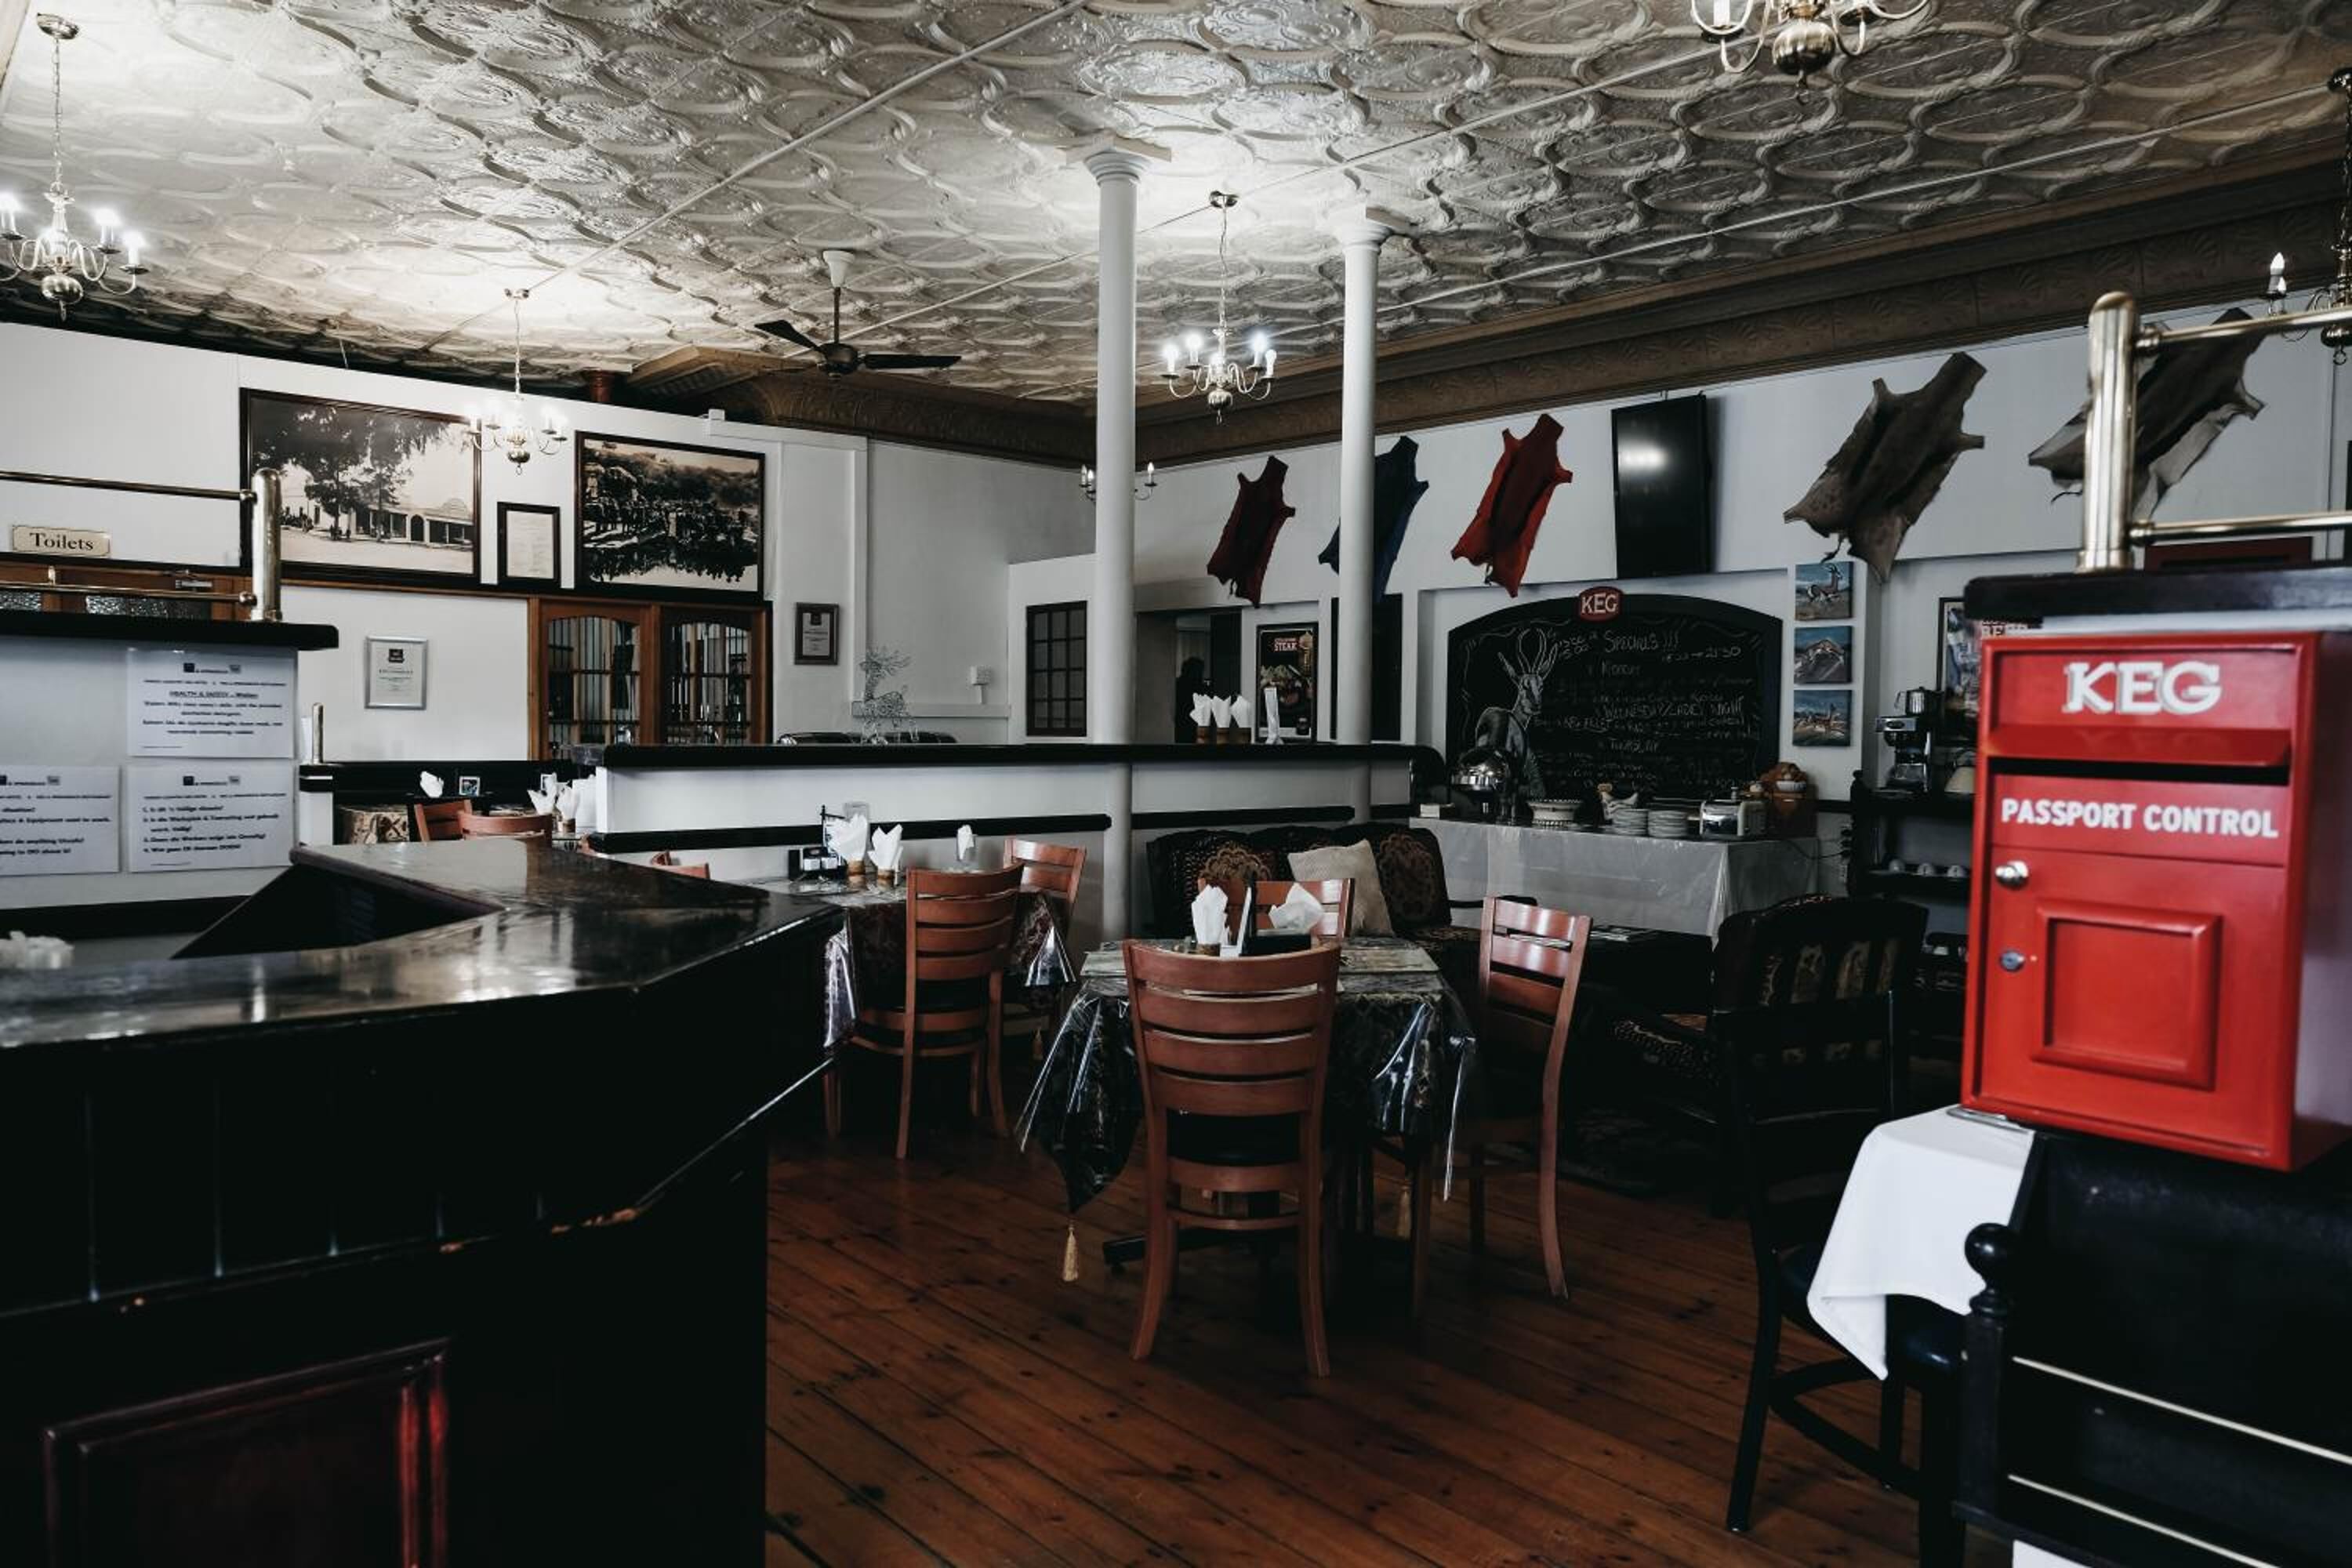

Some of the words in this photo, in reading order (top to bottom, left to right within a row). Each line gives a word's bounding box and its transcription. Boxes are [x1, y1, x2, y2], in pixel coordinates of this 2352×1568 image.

[30, 532, 93, 550] Toilets
[1581, 592, 1618, 613] KEG
[1274, 642, 1298, 652] STEAK
[2062, 660, 2222, 715] KEG
[2001, 798, 2136, 830] PASSPORT
[2143, 804, 2279, 838] CONTROL
